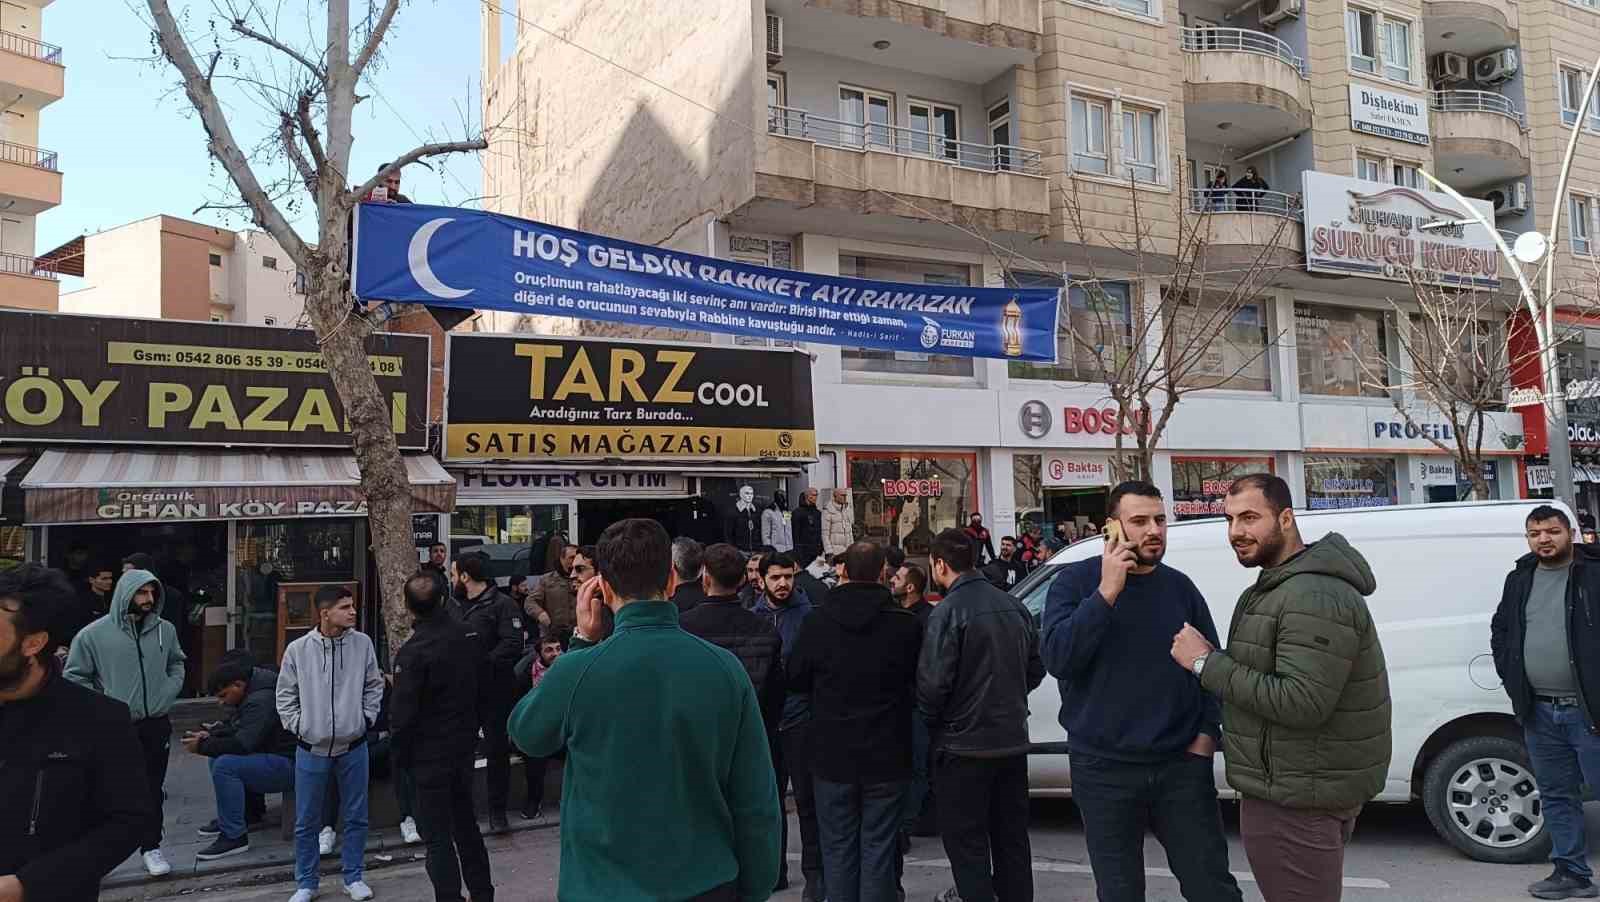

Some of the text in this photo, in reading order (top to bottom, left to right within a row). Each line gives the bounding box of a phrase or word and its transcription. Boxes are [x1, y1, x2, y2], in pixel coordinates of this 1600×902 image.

[1361, 91, 1418, 116] Dişhekimi
[1313, 220, 1414, 264] SÜRÜCÜ
[1422, 241, 1498, 275] KURSU
[513, 230, 975, 315] HOŞ GELDİN RAHMET AYI RAMAZAN
[514, 272, 583, 290] Oruçlunun
[587, 280, 670, 302] rahatlayacağı
[690, 294, 727, 309] sevinç
[730, 299, 747, 310] anı
[751, 302, 786, 314] vardır:
[789, 304, 816, 317] Birisi
[843, 311, 870, 324] ettiği
[871, 316, 907, 328] zaman,
[514, 290, 554, 306] diğeri
[558, 294, 574, 308] de
[577, 299, 637, 315] orucunun
[640, 305, 696, 322] sevabıyla
[700, 311, 745, 326] Rabbine
[748, 316, 804, 334] kavuştuğu
[807, 323, 836, 336] andır.
[942, 329, 975, 341] FURKAN
[133, 350, 171, 362] Gsm:
[176, 351, 210, 364] 0542
[215, 353, 241, 366] 806
[246, 355, 263, 367] 35
[267, 356, 284, 368] 39
[380, 362, 394, 372] 08
[514, 343, 769, 407] TARZ COOL
[0, 367, 407, 434] ÖY PAZAI
[529, 405, 693, 422] Aradığınız Tarz Burada...
[465, 427, 722, 456] SATIŞ MAĞAZASI
[462, 471, 581, 487] FLOWER
[884, 480, 940, 496] BOSCH
[219, 499, 285, 517] KÖY
